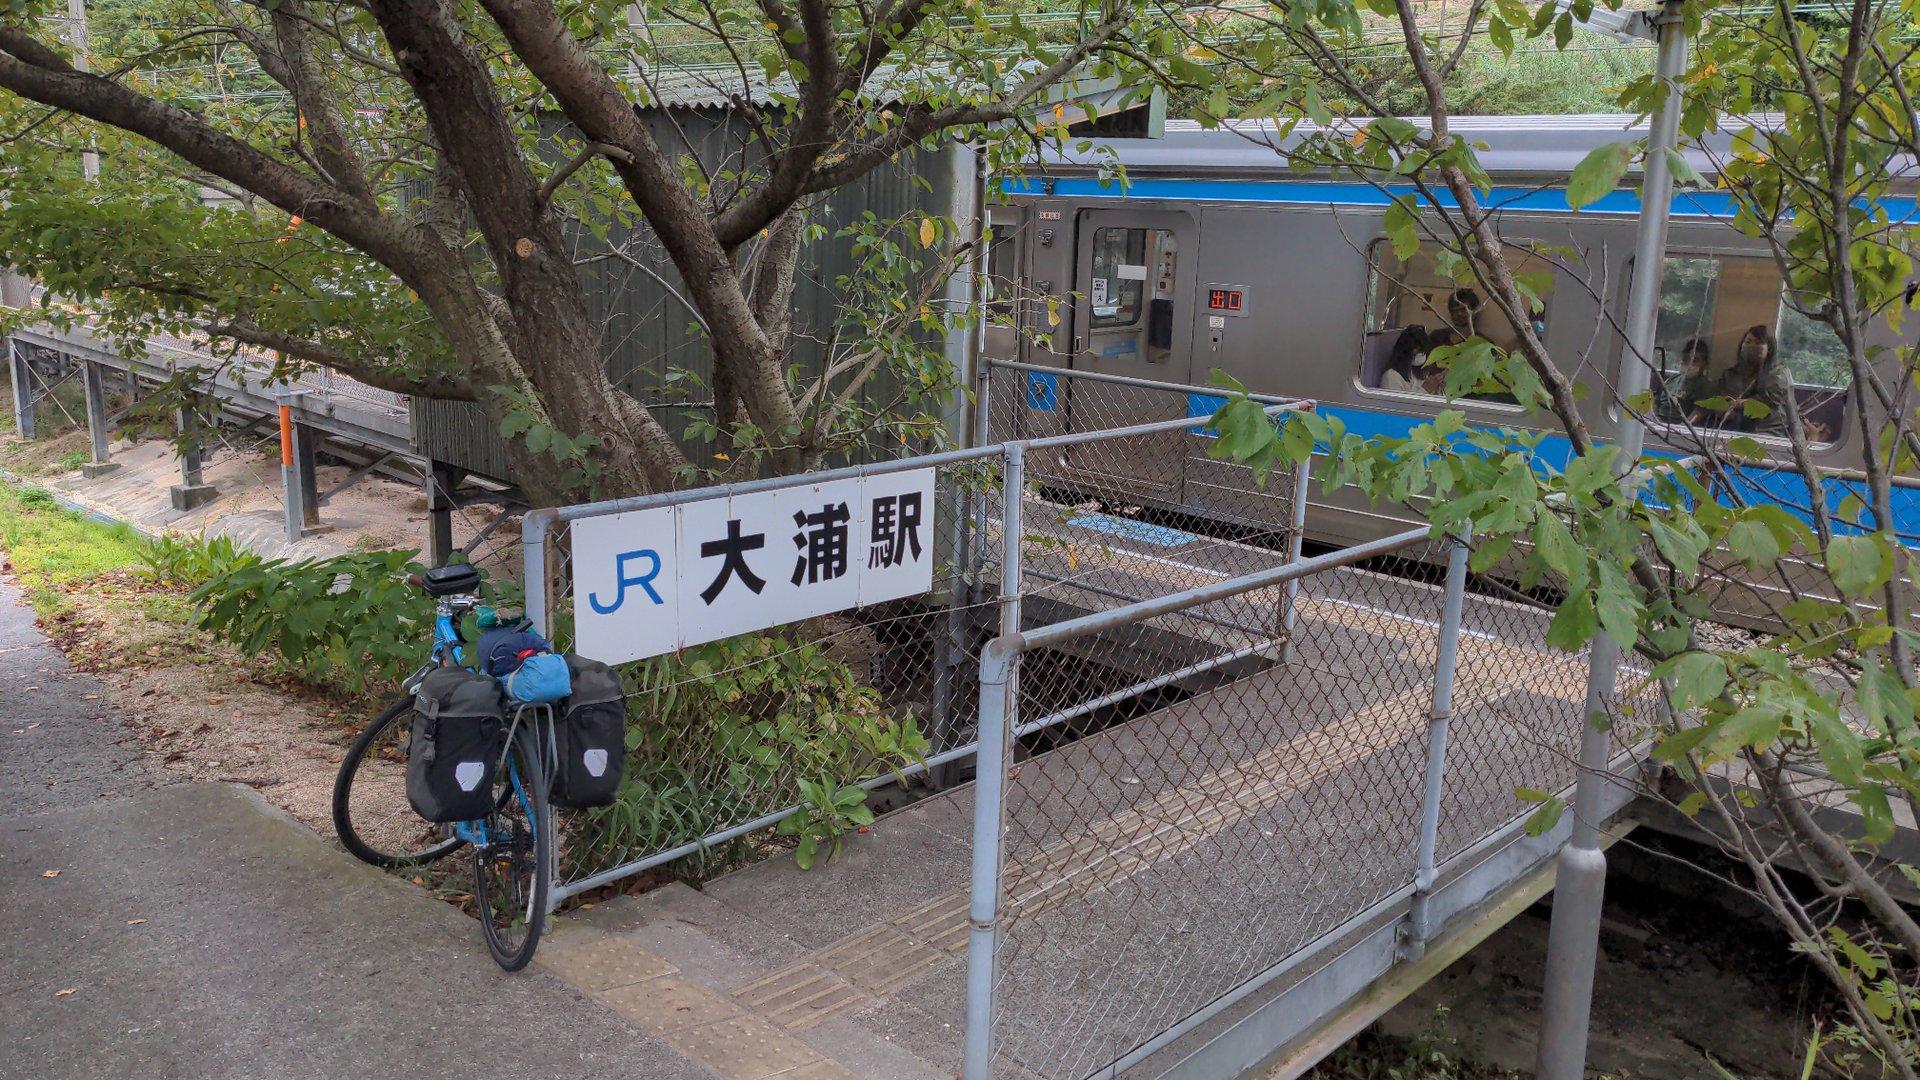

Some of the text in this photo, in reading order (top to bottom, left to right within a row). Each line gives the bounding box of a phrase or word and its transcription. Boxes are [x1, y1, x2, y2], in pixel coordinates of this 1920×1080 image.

[1212, 290, 1242, 309] 出口
[588, 491, 924, 615] JR 大浦駅
